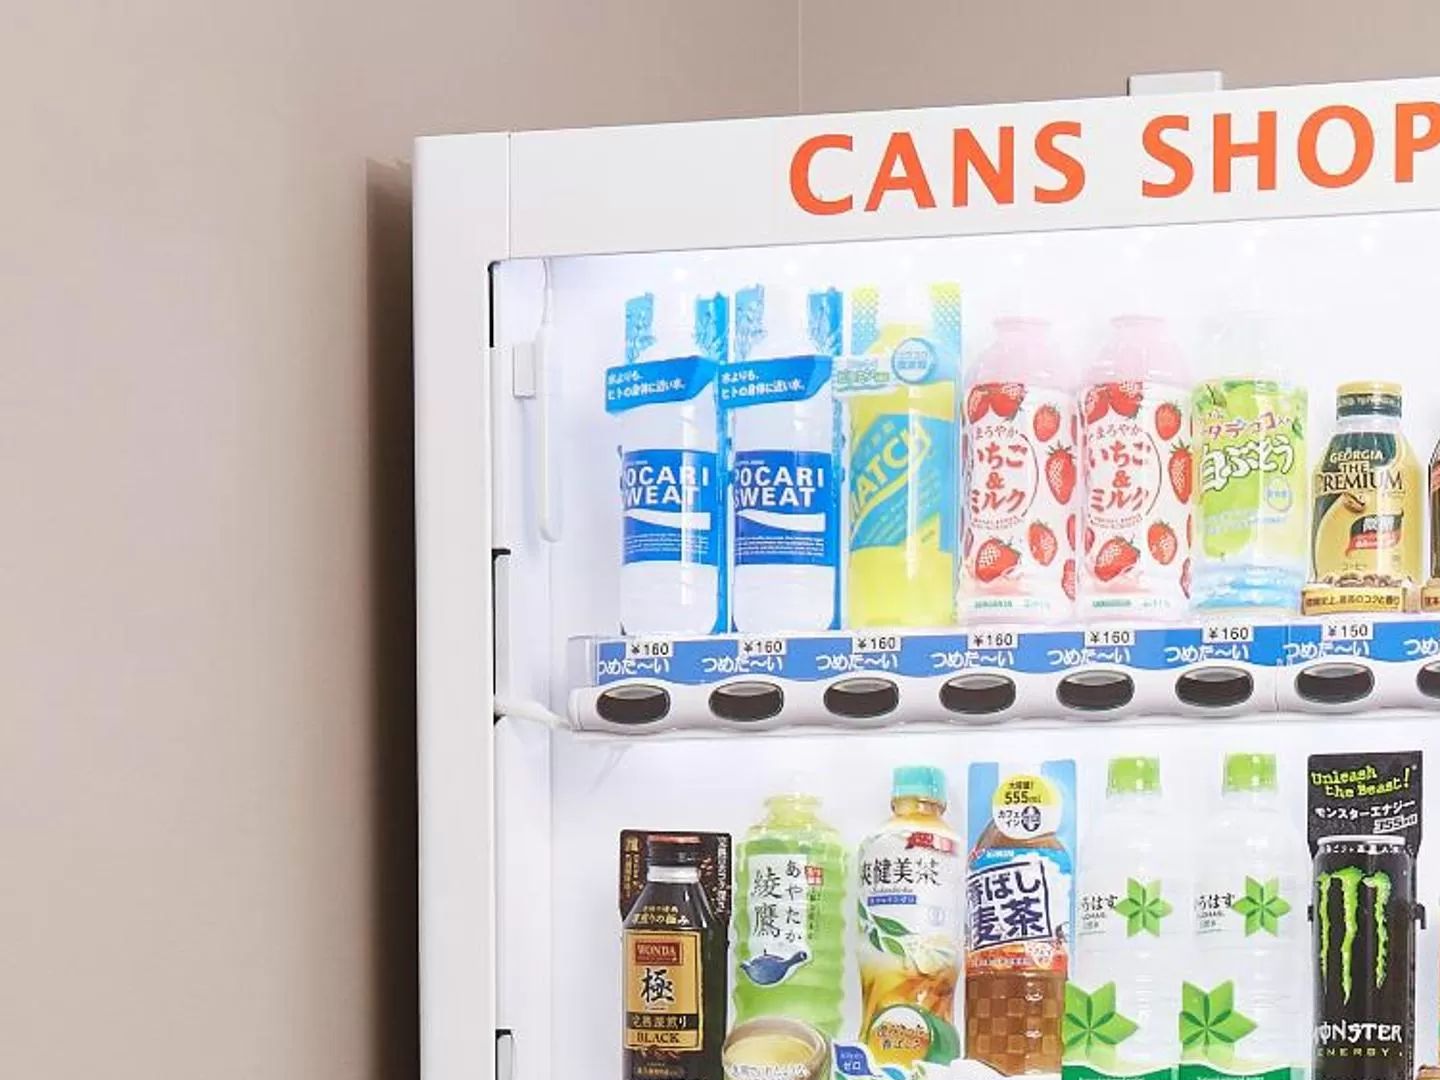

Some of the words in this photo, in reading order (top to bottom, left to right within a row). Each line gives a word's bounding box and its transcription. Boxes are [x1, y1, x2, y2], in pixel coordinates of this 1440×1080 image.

[789, 120, 1085, 215] CANS
[986, 471, 1004, 489] &
[1112, 471, 1131, 489] &
[972, 489, 1026, 511] ミルク
[1091, 488, 1149, 511] ミルク
[1090, 630, 1130, 645] ¥160
[1209, 627, 1249, 641] ¥160
[1328, 623, 1369, 637] ¥150
[631, 642, 669, 656] ¥160
[744, 640, 783, 654] ¥160
[857, 637, 896, 650] ¥160
[974, 633, 1013, 647] ¥160
[1312, 765, 1377, 785] Unleash
[1325, 783, 1355, 799] the
[1358, 767, 1410, 796] Beast!
[1315, 800, 1415, 819] モンスターエナジー
[785, 860, 802, 944] あやたか
[973, 898, 1045, 949] 麦茶
[641, 968, 674, 1003] 極
[1317, 1021, 1402, 1044] ONSTER
